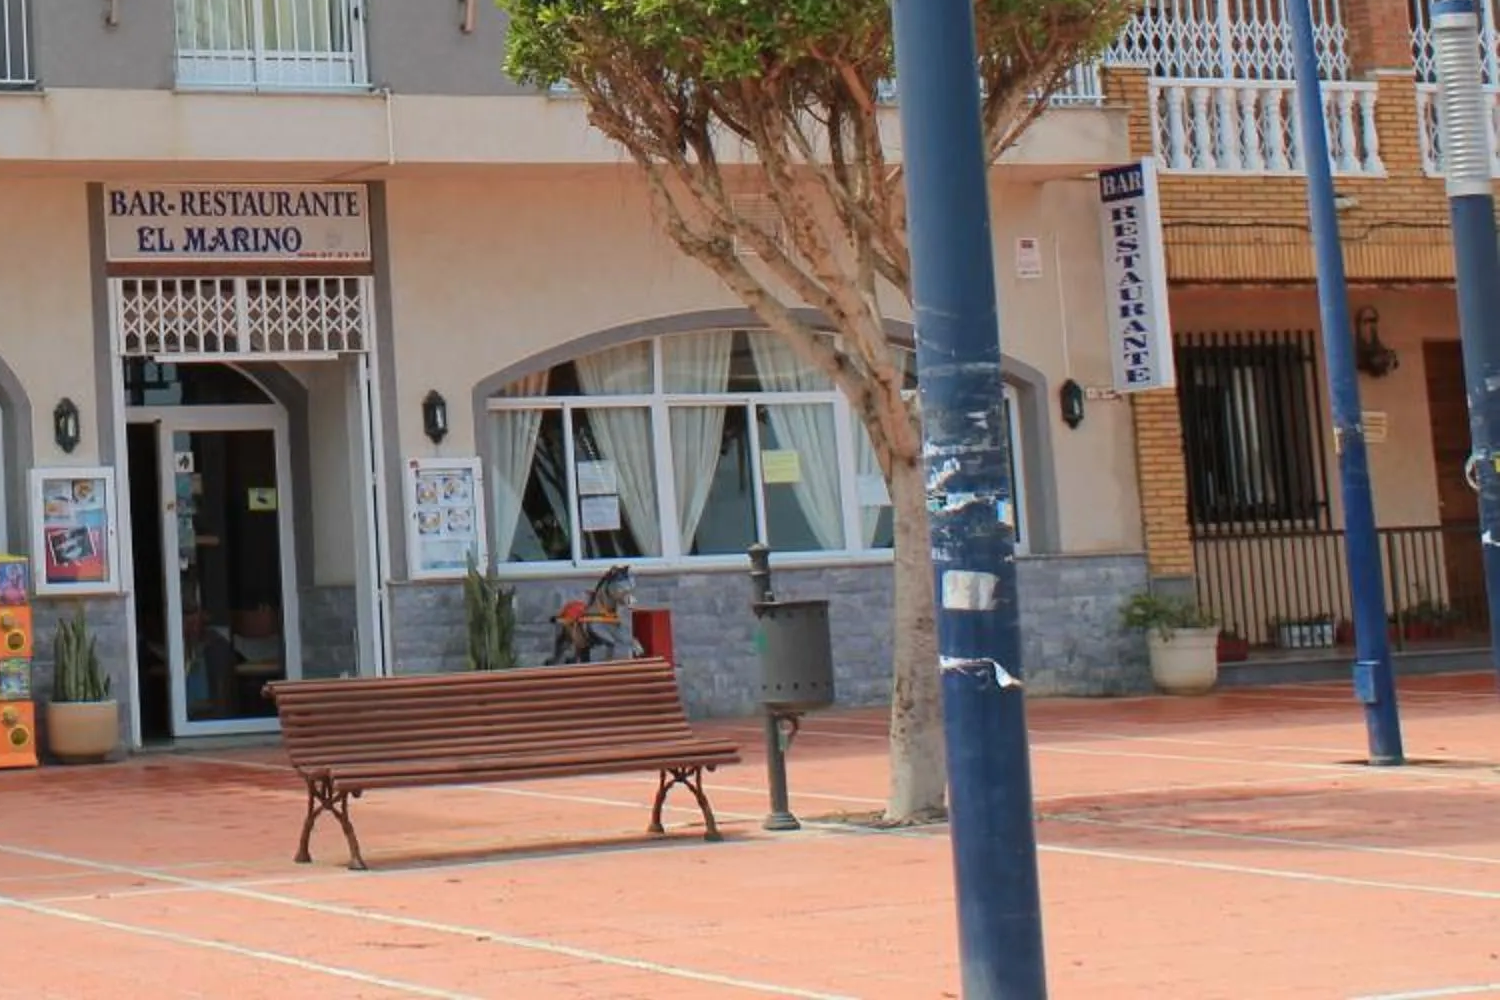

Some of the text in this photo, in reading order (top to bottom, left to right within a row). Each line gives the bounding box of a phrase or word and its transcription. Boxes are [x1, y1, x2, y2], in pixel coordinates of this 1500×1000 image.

[1102, 170, 1142, 197] BAR
[136, 227, 303, 252] EL MARINO
[1111, 206, 1150, 383] RESTAURANTE
